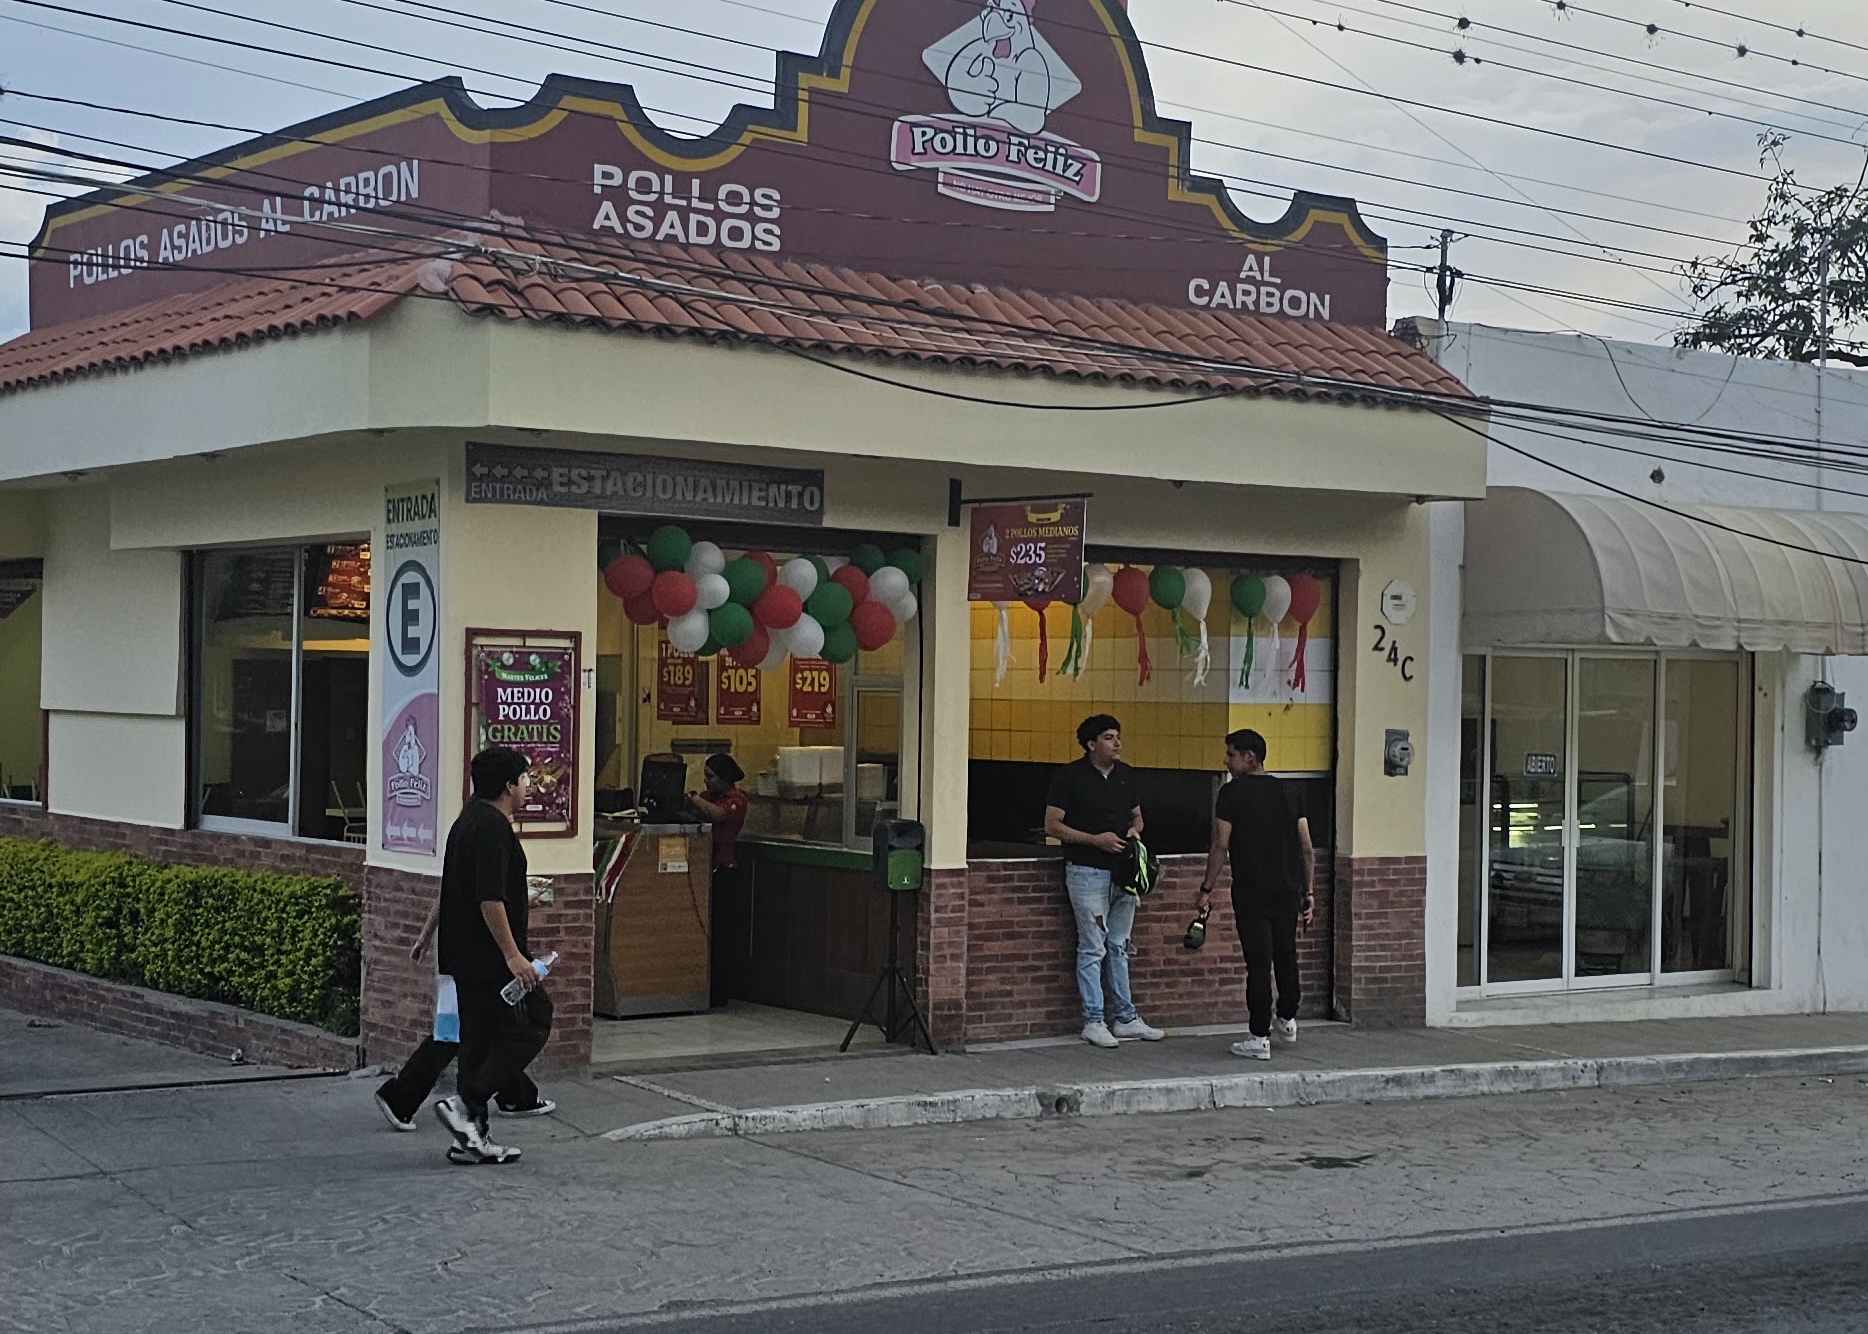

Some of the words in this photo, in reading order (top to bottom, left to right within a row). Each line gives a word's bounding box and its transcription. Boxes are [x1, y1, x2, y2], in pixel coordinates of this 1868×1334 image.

[911, 125, 999, 158] Pollo
[1006, 134, 1084, 183] Feliz
[593, 163, 781, 220] POLLOS
[69, 235, 150, 288] POLLOS
[158, 206, 249, 265] ASADOS
[259, 196, 291, 240] AL
[303, 159, 420, 223] CARBON
[592, 200, 781, 252] ASADOS
[1239, 253, 1282, 284] AL
[1188, 277, 1331, 321] CARBON
[470, 482, 549, 502] ENTRADA
[550, 466, 821, 512] ESTACIONAMIENTO
[386, 491, 438, 524] ENTRADA
[1010, 527, 1038, 539] POLLOS
[1039, 525, 1079, 538] MEDIANOS
[1009, 542, 1046, 565] $235
[401, 581, 421, 656] E
[662, 665, 693, 685] $189
[721, 668, 758, 692] $105
[795, 670, 830, 693] $219
[496, 687, 553, 704] MEDIO
[497, 704, 552, 721] POLLO
[487, 723, 562, 743] GRATIS
[1527, 756, 1555, 773] ABIERTO
